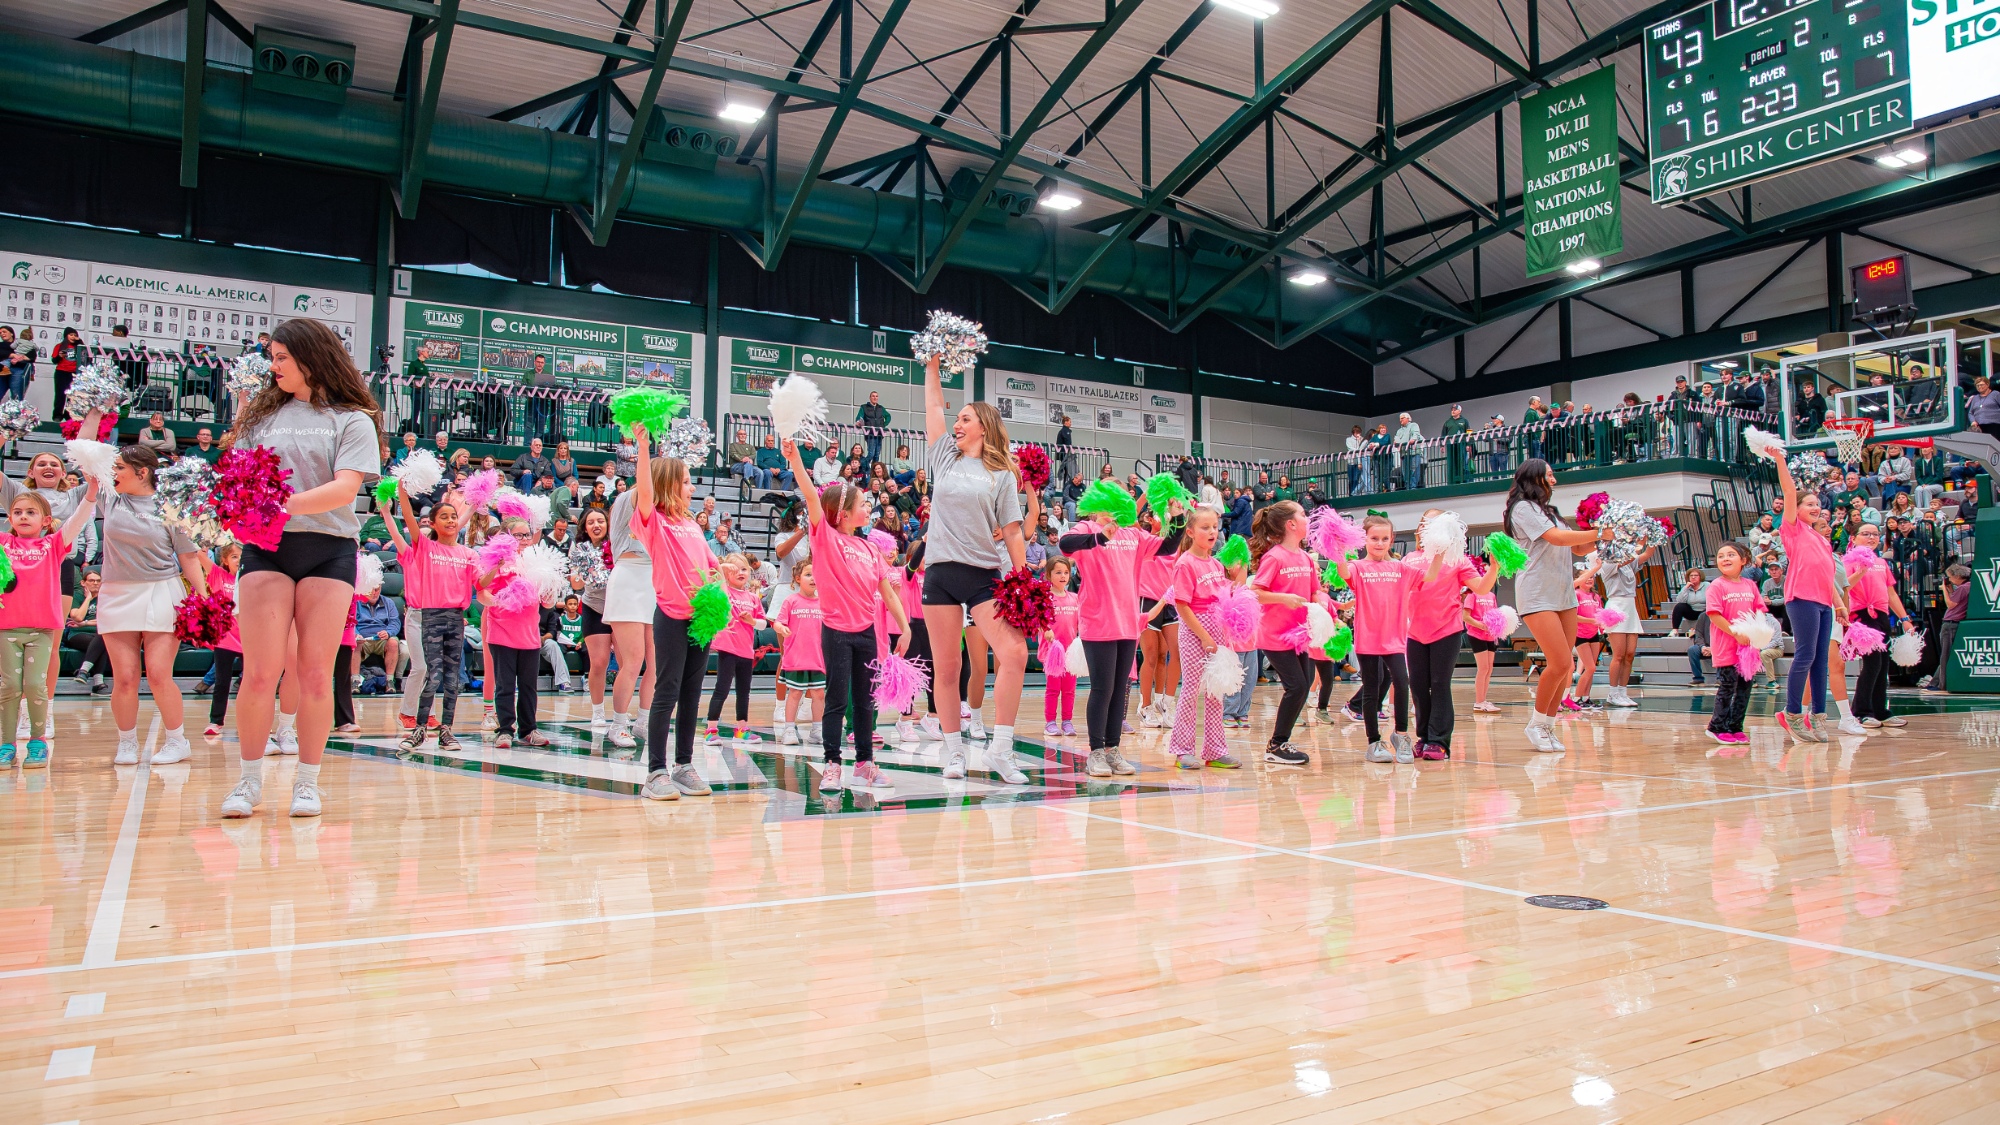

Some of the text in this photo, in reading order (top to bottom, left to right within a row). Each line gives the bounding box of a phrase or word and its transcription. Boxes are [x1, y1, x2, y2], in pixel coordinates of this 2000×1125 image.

[1653, 20, 1681, 39] TITANS
[1794, 18, 1809, 47] 2
[1863, 31, 1884, 49] FLS
[1662, 30, 1703, 69] 43
[1750, 42, 1782, 65] period
[1819, 49, 1838, 63] TOL
[1749, 66, 1786, 88] PLAYER
[1822, 68, 1839, 98] 5
[1547, 93, 1586, 119] NCAA
[1701, 90, 1717, 104] TOL
[1742, 83, 1797, 124] 2-23
[1666, 101, 1683, 116] FLS
[1545, 114, 1590, 142] DIV. III
[1677, 118, 1691, 142] 7
[1704, 109, 1719, 136] 6
[1695, 98, 1904, 179] SHIRK CENTER
[1547, 138, 1590, 164] MEN'S
[1526, 153, 1616, 194] BASKETBALL
[1535, 180, 1605, 214] NATIONAL
[1531, 200, 1614, 237] CHAMPIONS
[1558, 232, 1585, 253] 1997
[1868, 260, 1896, 279] 12:49
[96, 274, 169, 292] ACADEMIC
[175, 283, 268, 303] ALL-AMERICA
[397, 273, 408, 291] L
[425, 310, 463, 325] TITANS
[509, 321, 618, 344] CHAMPIONSHIPS
[643, 335, 677, 347] TITANS
[873, 334, 885, 349] M
[1743, 332, 1755, 341] EXIT
[747, 347, 780, 359] TITANS
[816, 356, 905, 377] CHAMPIONSHIPS
[1135, 369, 1143, 382] N
[1014, 382, 1035, 391] TITANS
[1050, 382, 1139, 402] TITAN TRAILBLAZERS
